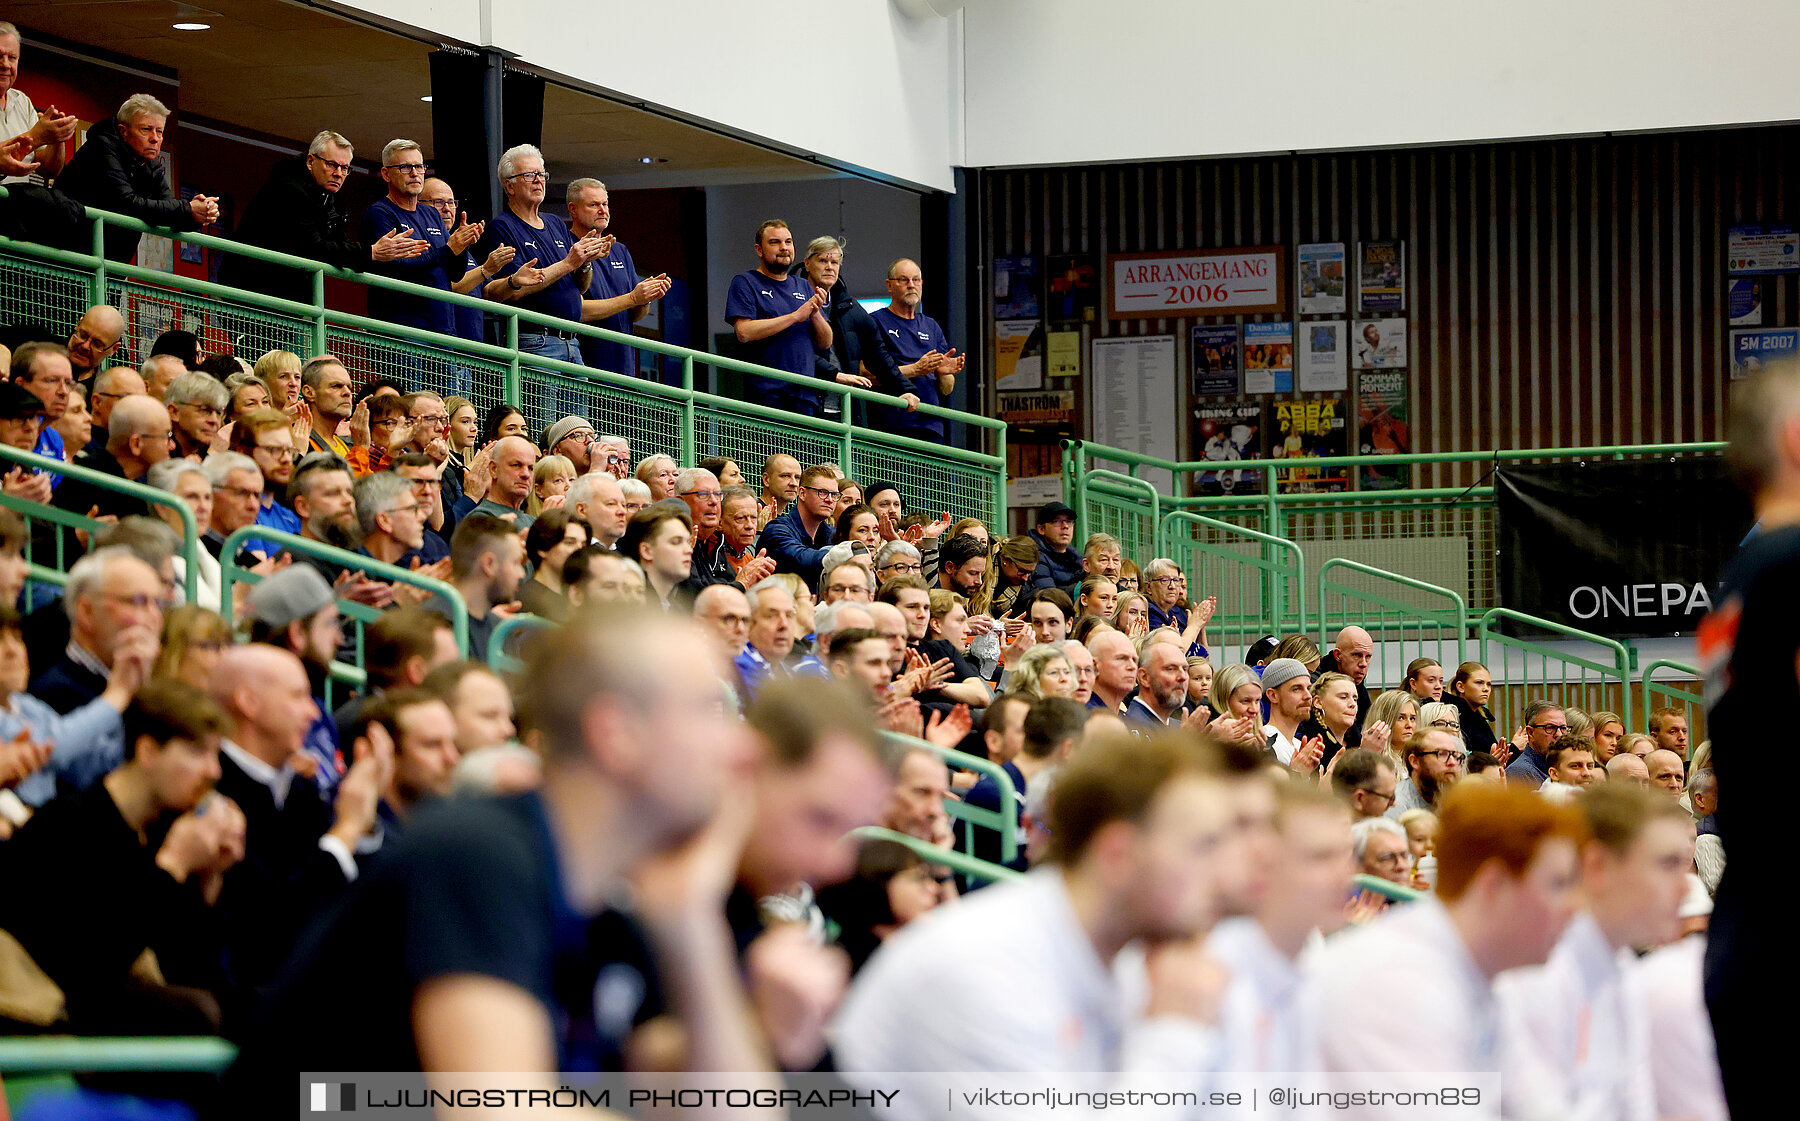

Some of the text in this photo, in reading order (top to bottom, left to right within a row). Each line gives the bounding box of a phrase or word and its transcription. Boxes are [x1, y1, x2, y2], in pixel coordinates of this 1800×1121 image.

[1123, 258, 1268, 284] ARRANGEMANG
[1164, 282, 1229, 305] 2006
[1248, 323, 1272, 332] Dans
[1740, 335, 1794, 351] SM 2007
[1360, 374, 1404, 385] SOMMAR-
[1361, 382, 1402, 393] KONSERT
[1194, 407, 1260, 419] VIKING CUP
[1276, 404, 1336, 420] ABBA
[1568, 581, 1726, 619] ONEPA
